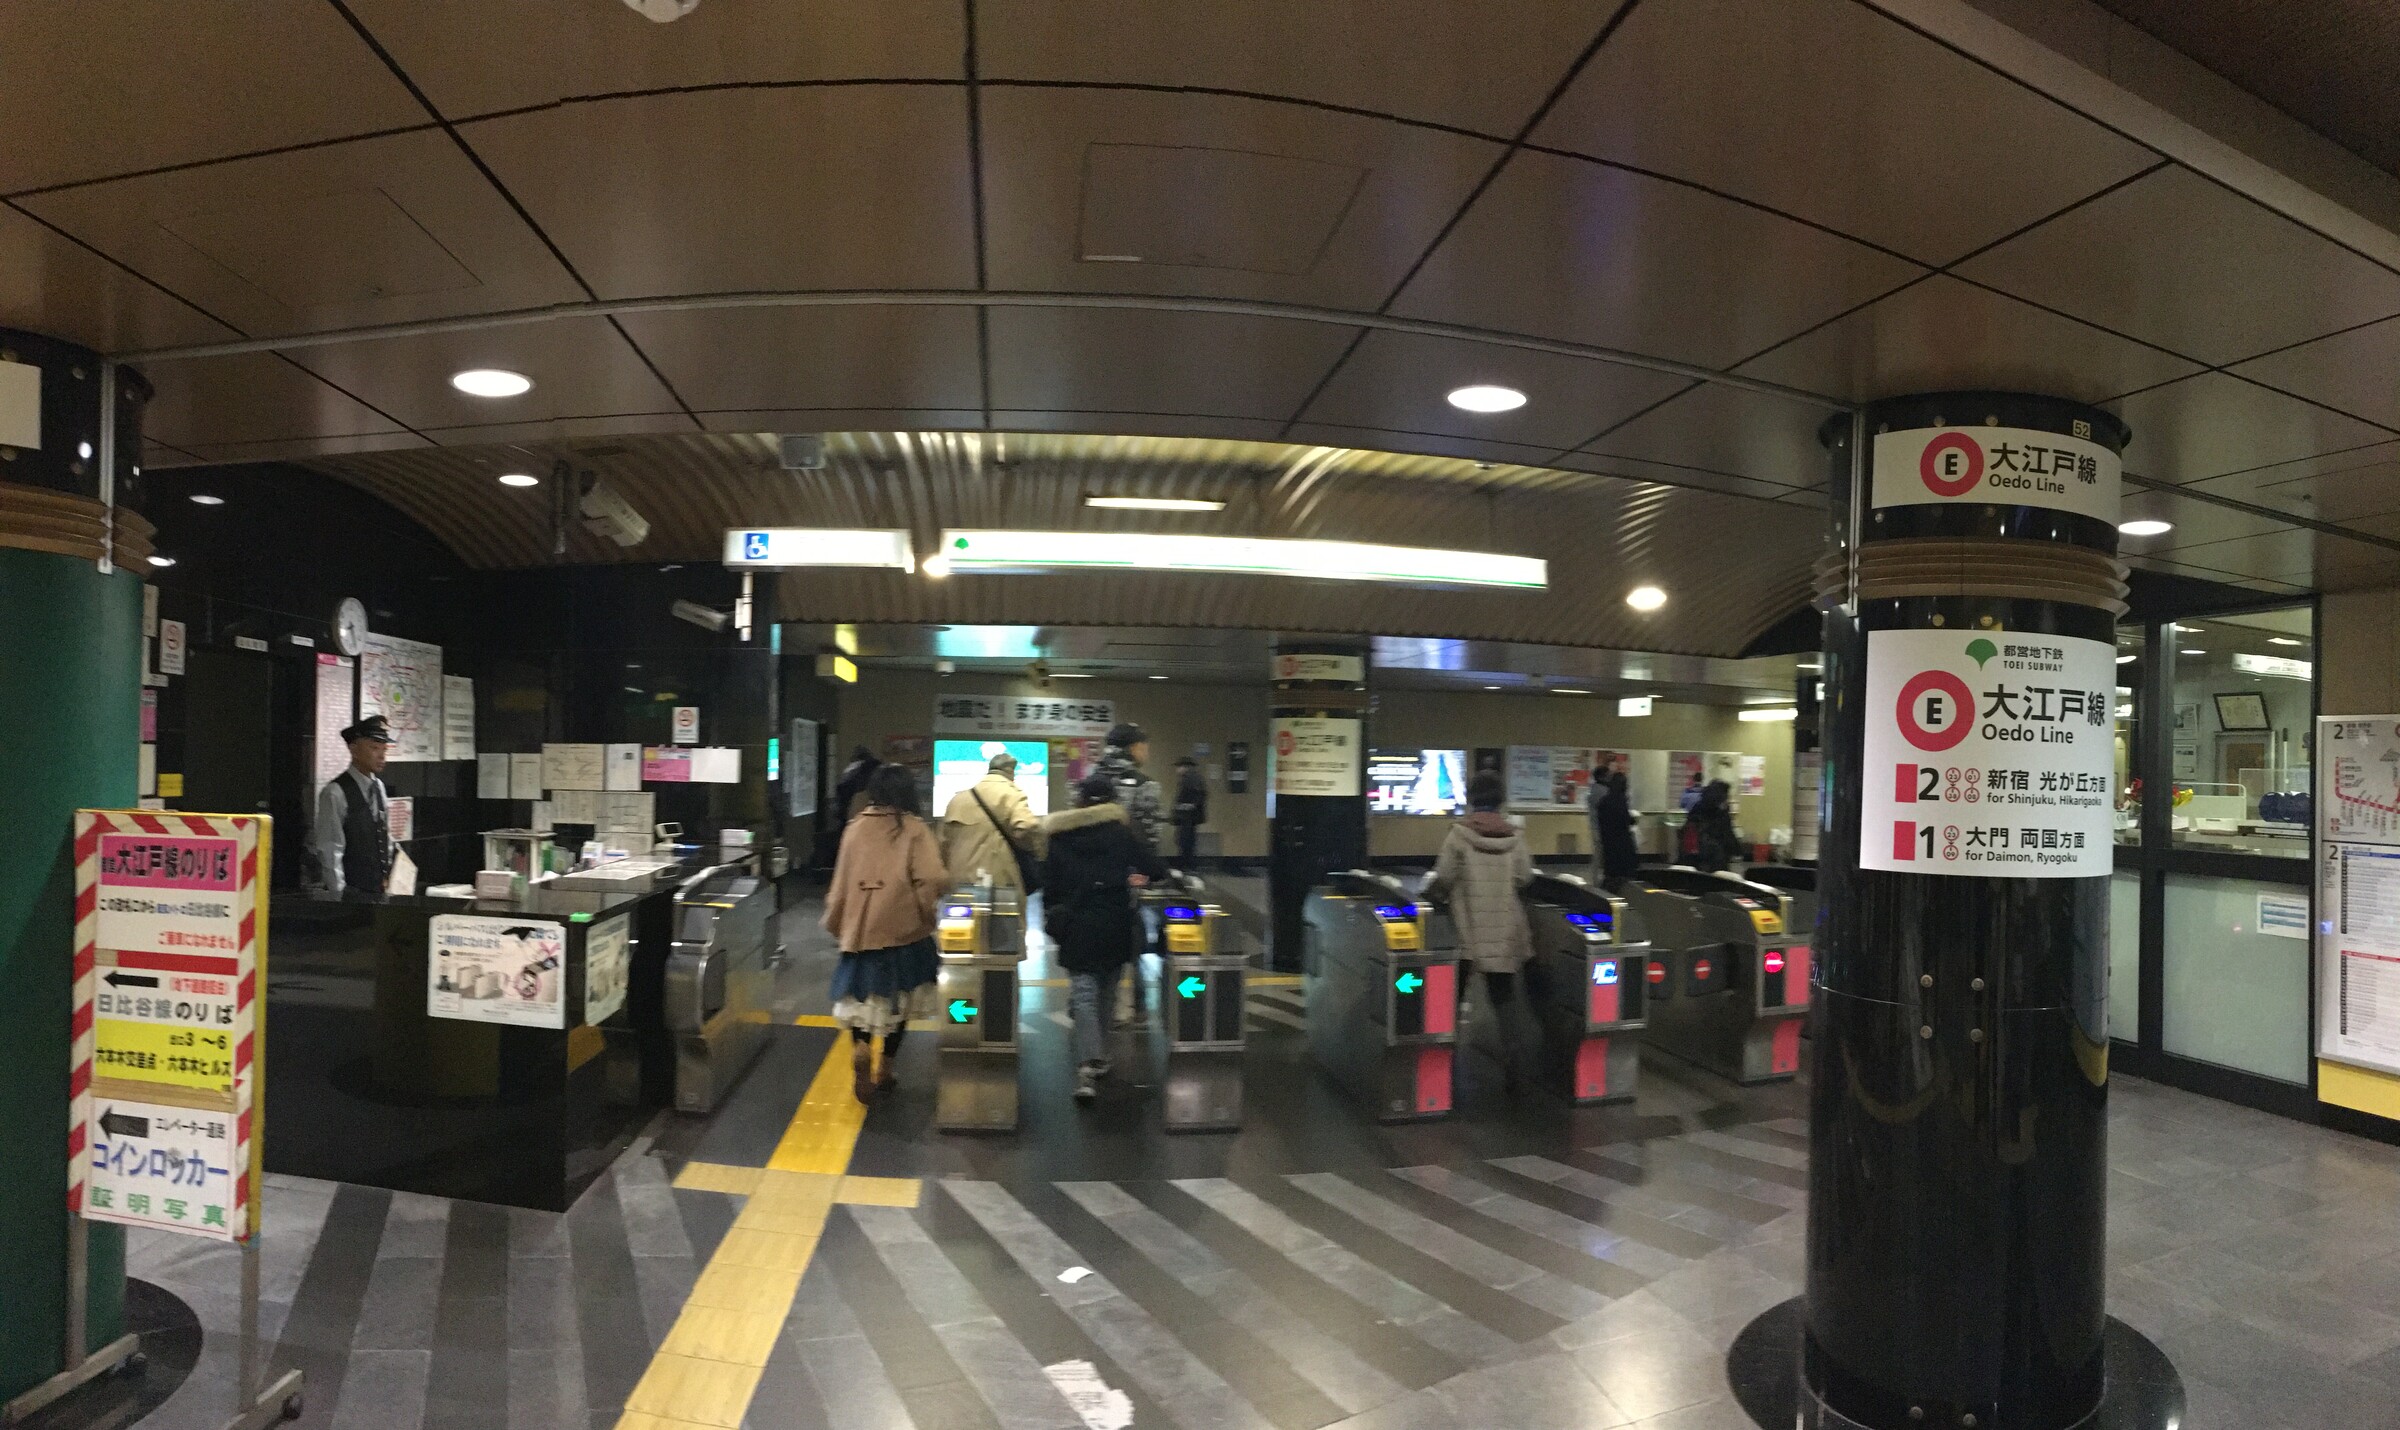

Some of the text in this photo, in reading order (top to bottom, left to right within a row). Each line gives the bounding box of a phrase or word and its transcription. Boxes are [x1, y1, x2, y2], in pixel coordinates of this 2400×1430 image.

[2074, 423, 2089, 437] 52
[1945, 454, 1958, 475] E
[1990, 443, 2096, 484] 大江戸線
[1989, 474, 2065, 494] Oedo Line
[2003, 645, 2063, 660] 都営地下鉄
[2003, 660, 2063, 672] TOEI SUBWAY
[1926, 698, 1943, 724] E
[1983, 684, 2106, 726] 大江戸線
[1982, 724, 2074, 744] Oedo Line
[2334, 724, 2344, 739] 2
[1918, 768, 2106, 800] 2 新宿 光が丘方面
[1987, 792, 2102, 808] for Shinjuku, Hikarigaoka
[1919, 826, 2085, 858] 1 大門 両国方面
[1965, 850, 2077, 865] for Daimon, Ryogoku
[2329, 845, 2338, 860] 2
[92, 1141, 229, 1186] コインロッカー
[90, 1186, 226, 1228] 証明写真
